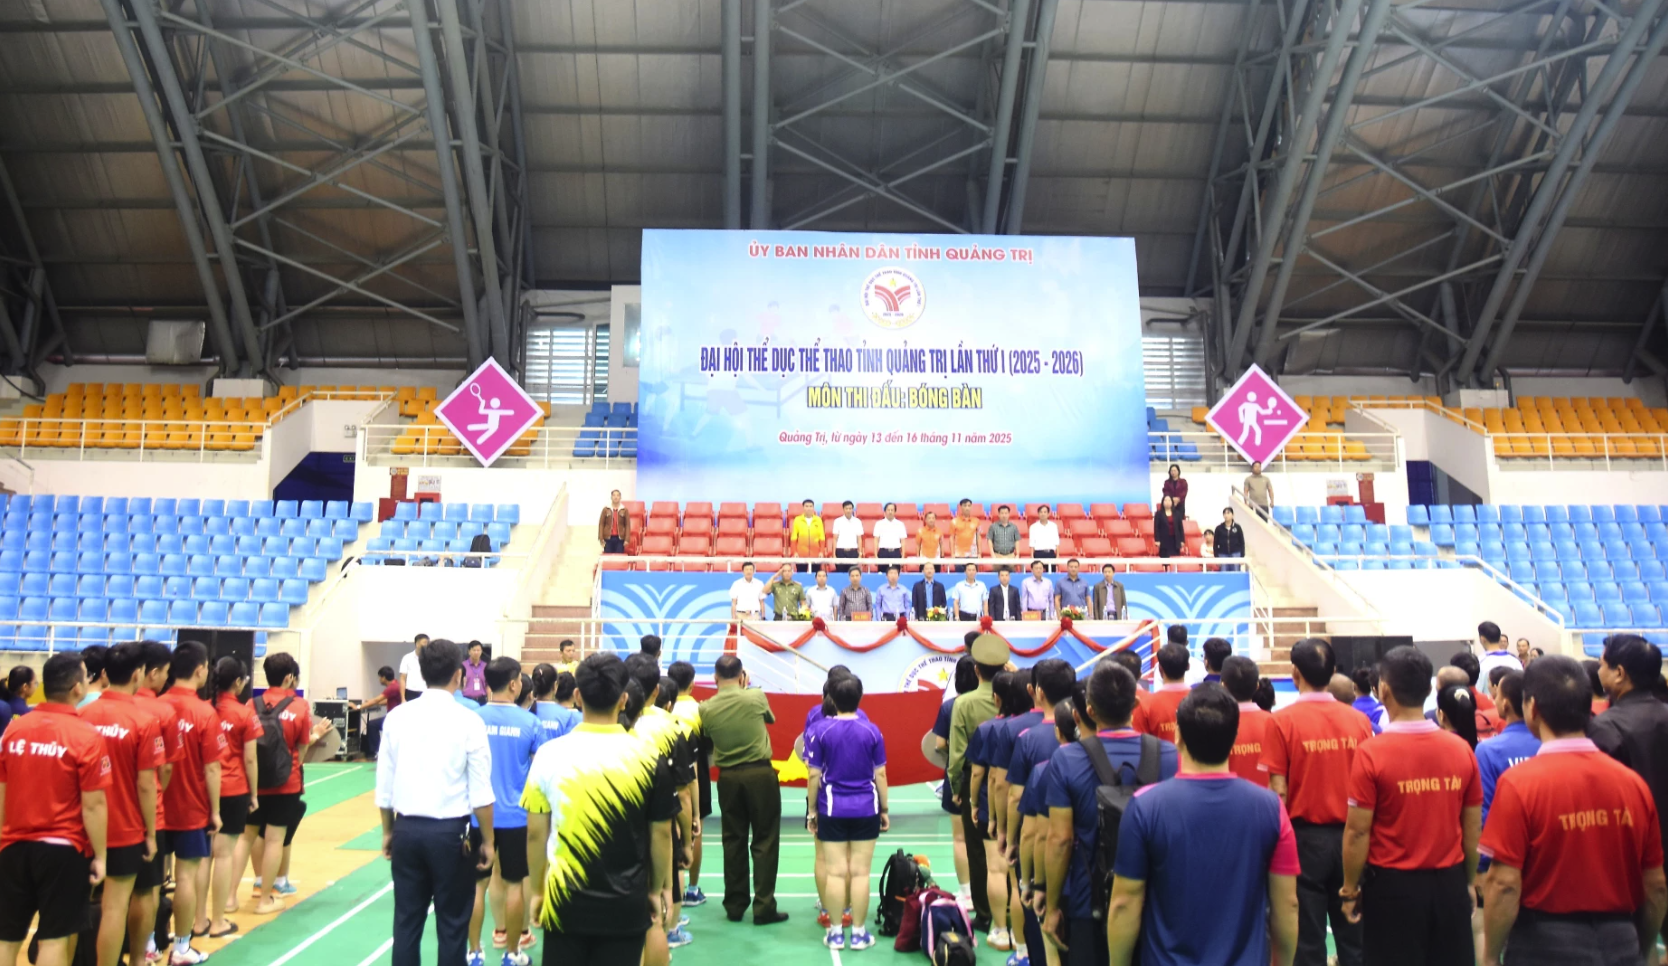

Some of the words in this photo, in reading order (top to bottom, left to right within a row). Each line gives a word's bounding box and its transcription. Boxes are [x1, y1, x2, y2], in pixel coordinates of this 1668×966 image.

[749, 240, 769, 257] ỦY
[775, 245, 808, 258] BAN
[813, 243, 860, 259] NHÂN
[865, 243, 900, 259] DÂN
[905, 243, 941, 260] TỈNH
[945, 244, 1005, 261] QUẢNG
[1010, 249, 1032, 264] TRỊ
[700, 347, 720, 377] ĐẠI
[724, 341, 744, 377] HỘI
[747, 336, 769, 372] THỂ
[772, 347, 795, 378] DỤC
[798, 337, 820, 372] THỂ
[823, 348, 853, 373] THAO
[856, 339, 882, 373] TỈNH
[886, 340, 926, 376] QUẢNG
[929, 349, 947, 379] TRỊ
[950, 340, 973, 373] LẦN
[976, 344, 998, 373] THỨ
[1001, 349, 1005, 374] I
[1009, 350, 1040, 376] (2025
[1051, 350, 1083, 377] 2026)
[807, 382, 842, 408] MÔN
[845, 386, 868, 408] THI
[870, 380, 906, 409] ĐẤU:
[908, 383, 949, 409] BÓNG
[951, 383, 982, 409] BÀN
[778, 430, 812, 446] Quảng
[815, 431, 828, 446] Trị,
[831, 431, 841, 443] từ
[843, 431, 867, 445] ngày
[871, 432, 882, 443] 13
[884, 430, 903, 443] đến
[906, 432, 917, 443] 16
[920, 432, 948, 446] tháng
[951, 432, 961, 443] 11
[964, 432, 986, 443] năm
[988, 432, 1012, 444] 2025
[928, 656, 943, 664] THAO
[9, 739, 26, 756] LỆ
[1302, 738, 1338, 753] TRỌNG
[1397, 778, 1440, 795] TRỌNG
[1613, 806, 1634, 827] TÀ
